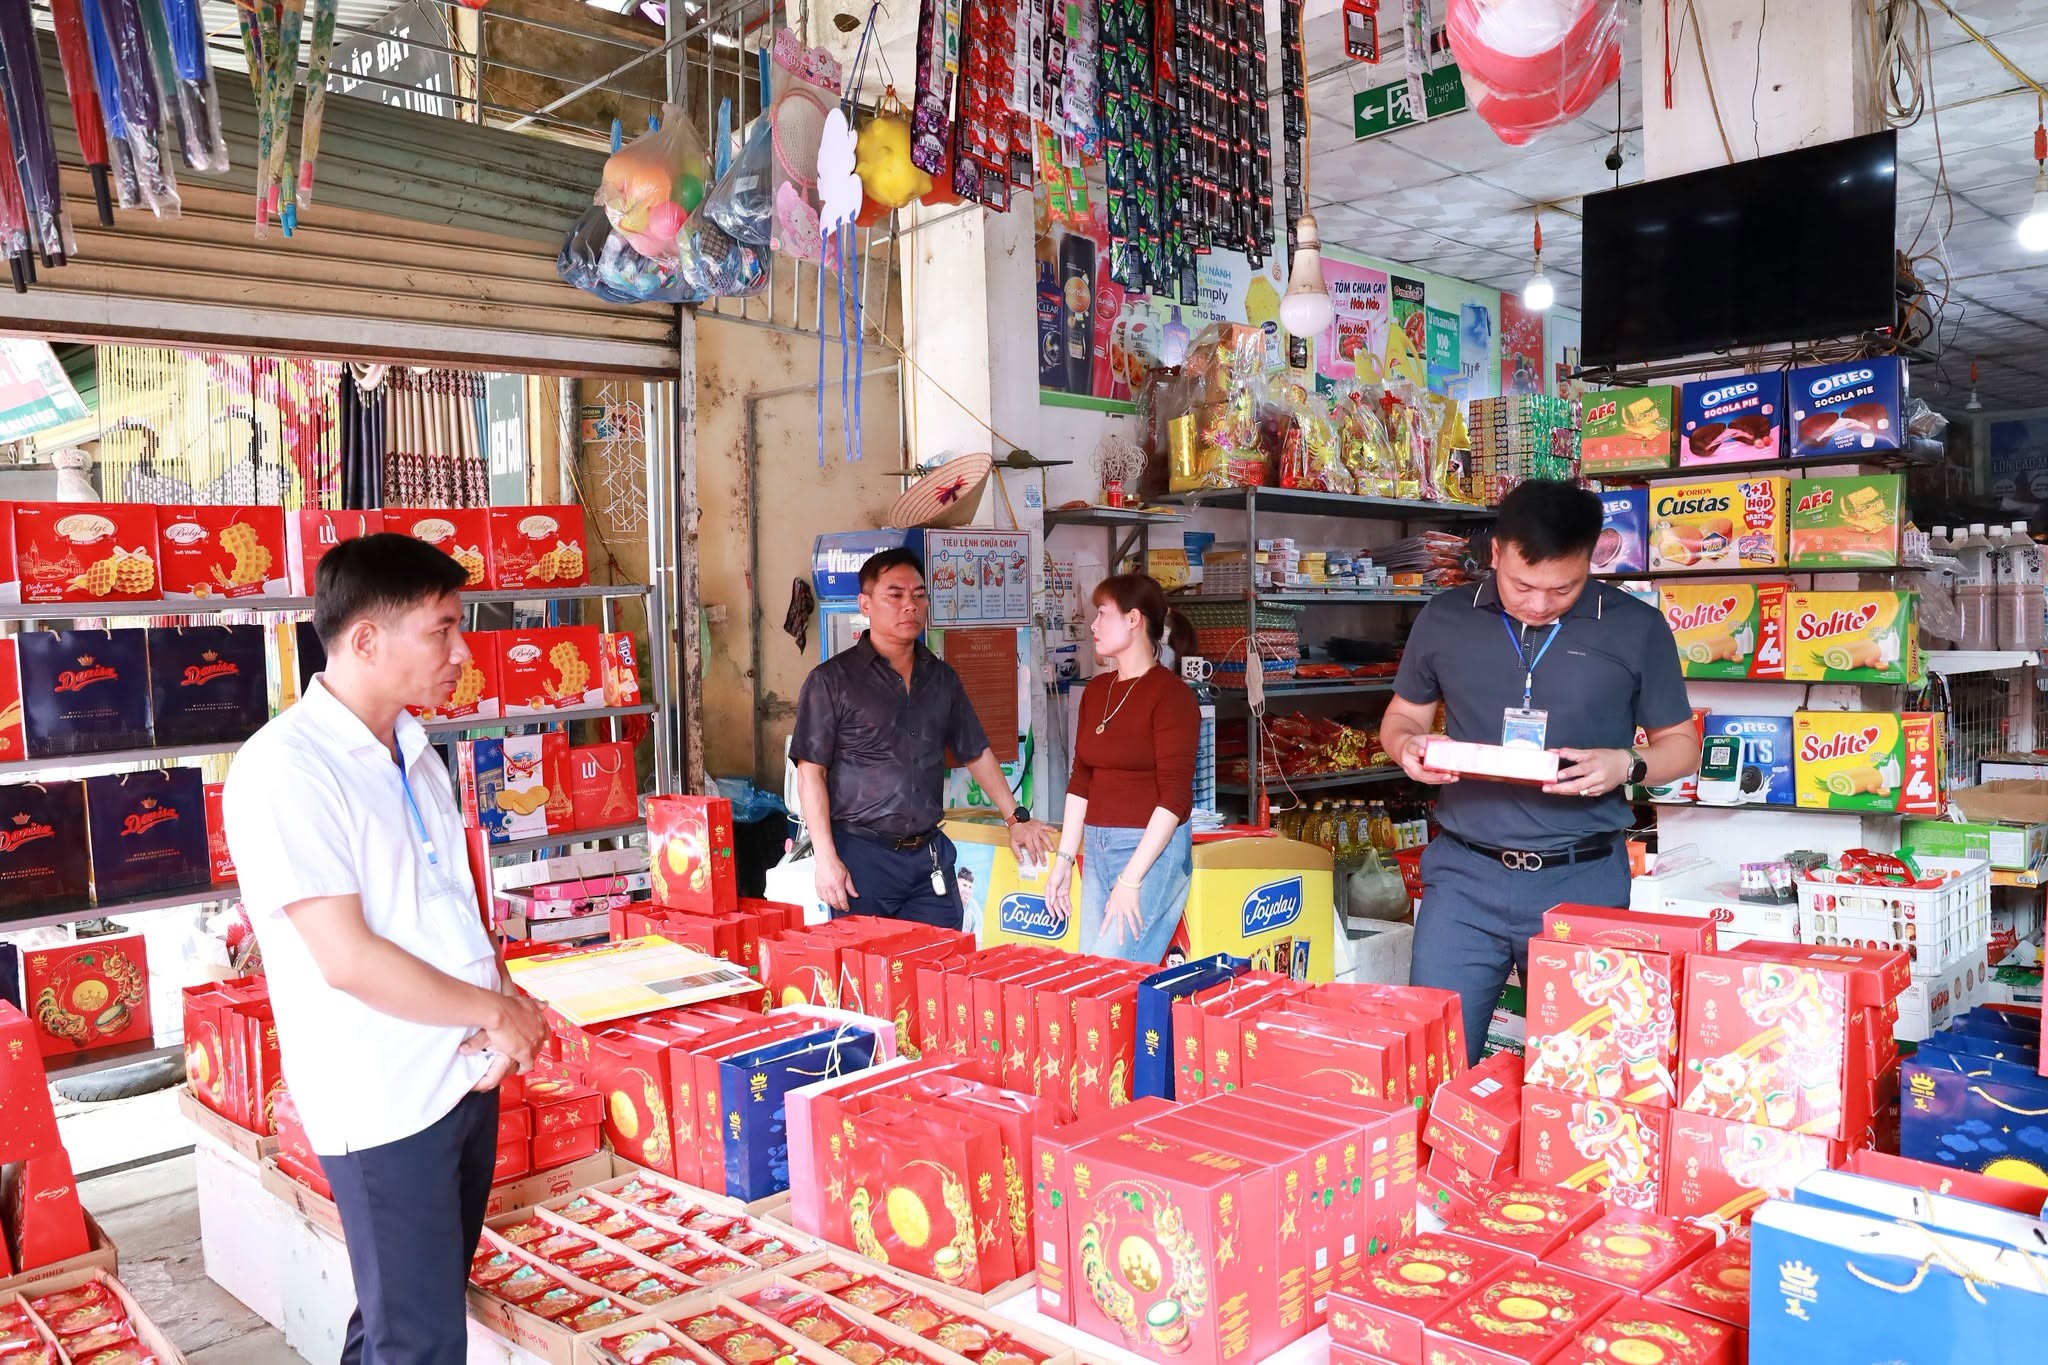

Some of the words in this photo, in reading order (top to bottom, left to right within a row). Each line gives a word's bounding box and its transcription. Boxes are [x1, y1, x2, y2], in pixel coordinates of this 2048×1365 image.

[377, 26, 410, 73] ĐẶT
[1435, 94, 1449, 105] EXIT
[1374, 283, 1387, 295] CAY
[1192, 309, 1209, 319] cho
[1350, 296, 1365, 311] Hảo
[1366, 296, 1380, 311] Hảo
[1428, 310, 1458, 332] Vinamilk
[1702, 381, 1759, 408] OREO
[1811, 369, 1873, 396] OREO
[1704, 401, 1741, 419] SOCOLA
[1742, 395, 1760, 409] PIE
[1814, 391, 1855, 409] SOCOLA
[1856, 385, 1875, 399] PIE
[1586, 400, 1617, 425] AFC
[1686, 487, 1712, 496] ORION
[1796, 490, 1833, 514] AFC
[1605, 500, 1631, 515] REO
[1657, 496, 1731, 517] Custas
[1746, 512, 1773, 522] Marine
[170, 526, 202, 539] Belgi
[319, 525, 337, 544] LU
[1667, 602, 1726, 633] Solite
[1761, 604, 1782, 620] 16
[1796, 610, 1865, 641] Solite
[1758, 637, 1782, 665] 4
[55, 664, 118, 693] Danisa
[180, 660, 240, 687] Danisa
[1725, 722, 1778, 735] OREO
[1800, 733, 1868, 762] Solite
[1907, 737, 1930, 753] 16
[582, 761, 597, 779] LU
[1906, 770, 1933, 800] 4
[120, 805, 180, 837] Danisa
[1003, 900, 1061, 934] Joyday
[1245, 894, 1298, 927] Joyday
[1711, 908, 1731, 921] 333
